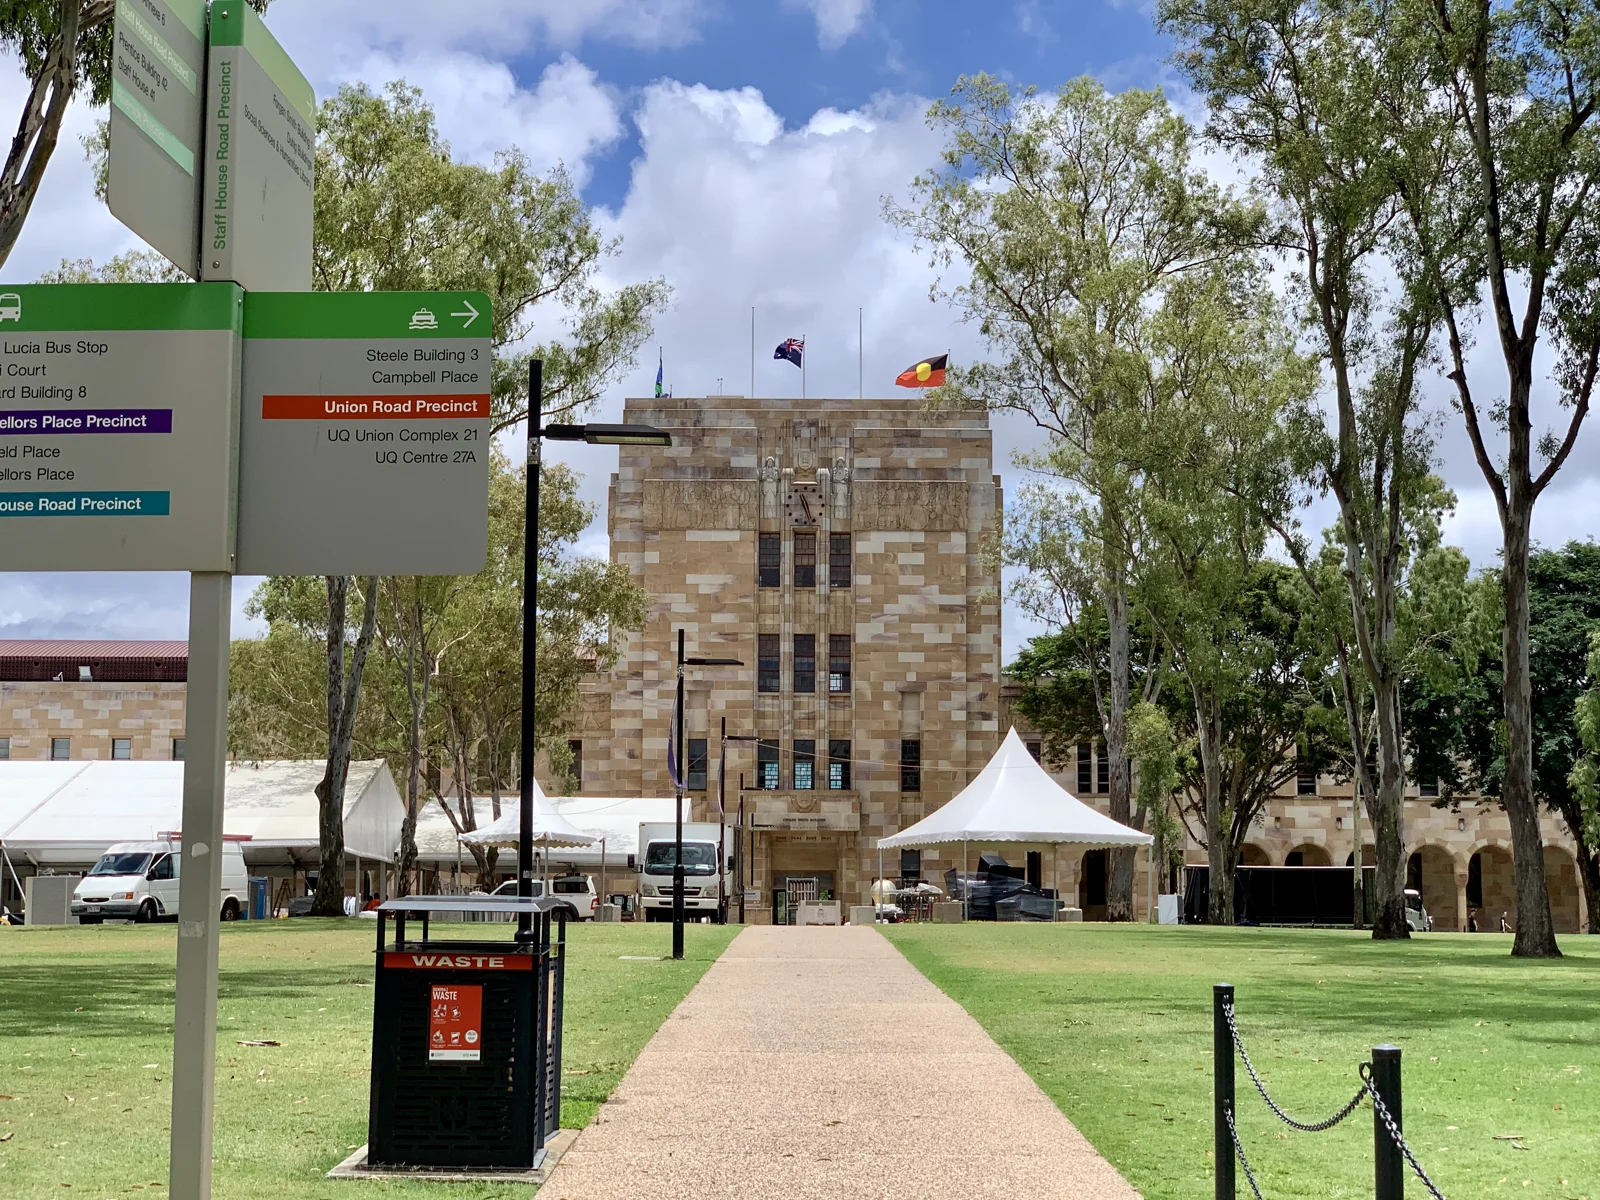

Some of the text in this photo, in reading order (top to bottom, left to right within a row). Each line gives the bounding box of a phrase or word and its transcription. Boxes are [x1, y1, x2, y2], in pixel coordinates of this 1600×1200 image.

[162, 14, 166, 26] 6
[120, 2, 188, 82] Staff House Road Precinct
[119, 31, 140, 63] Prentice
[141, 54, 160, 86] Building
[118, 56, 132, 78] Staff
[132, 70, 148, 96] House
[214, 61, 231, 250] Staff House Road Precinct
[4, 341, 108, 356] Lucia Bus Stop
[366, 349, 479, 364] Steele Building 3
[8, 364, 46, 376] Court
[372, 371, 479, 386] Campbell Place
[0, 386, 87, 401] rd Building 8
[325, 400, 478, 413] Union Road Precinct
[42, 415, 82, 428] Place
[86, 414, 147, 428] Precinct
[328, 429, 478, 444] UQ Union Complex 21
[23, 446, 60, 457] Place
[375, 451, 476, 464] UQ Centre 27A
[37, 468, 74, 480] Place
[38, 498, 76, 511] Road
[81, 497, 141, 510] Precinct
[412, 956, 504, 968] WASTE
[433, 991, 457, 1000] WASTE
